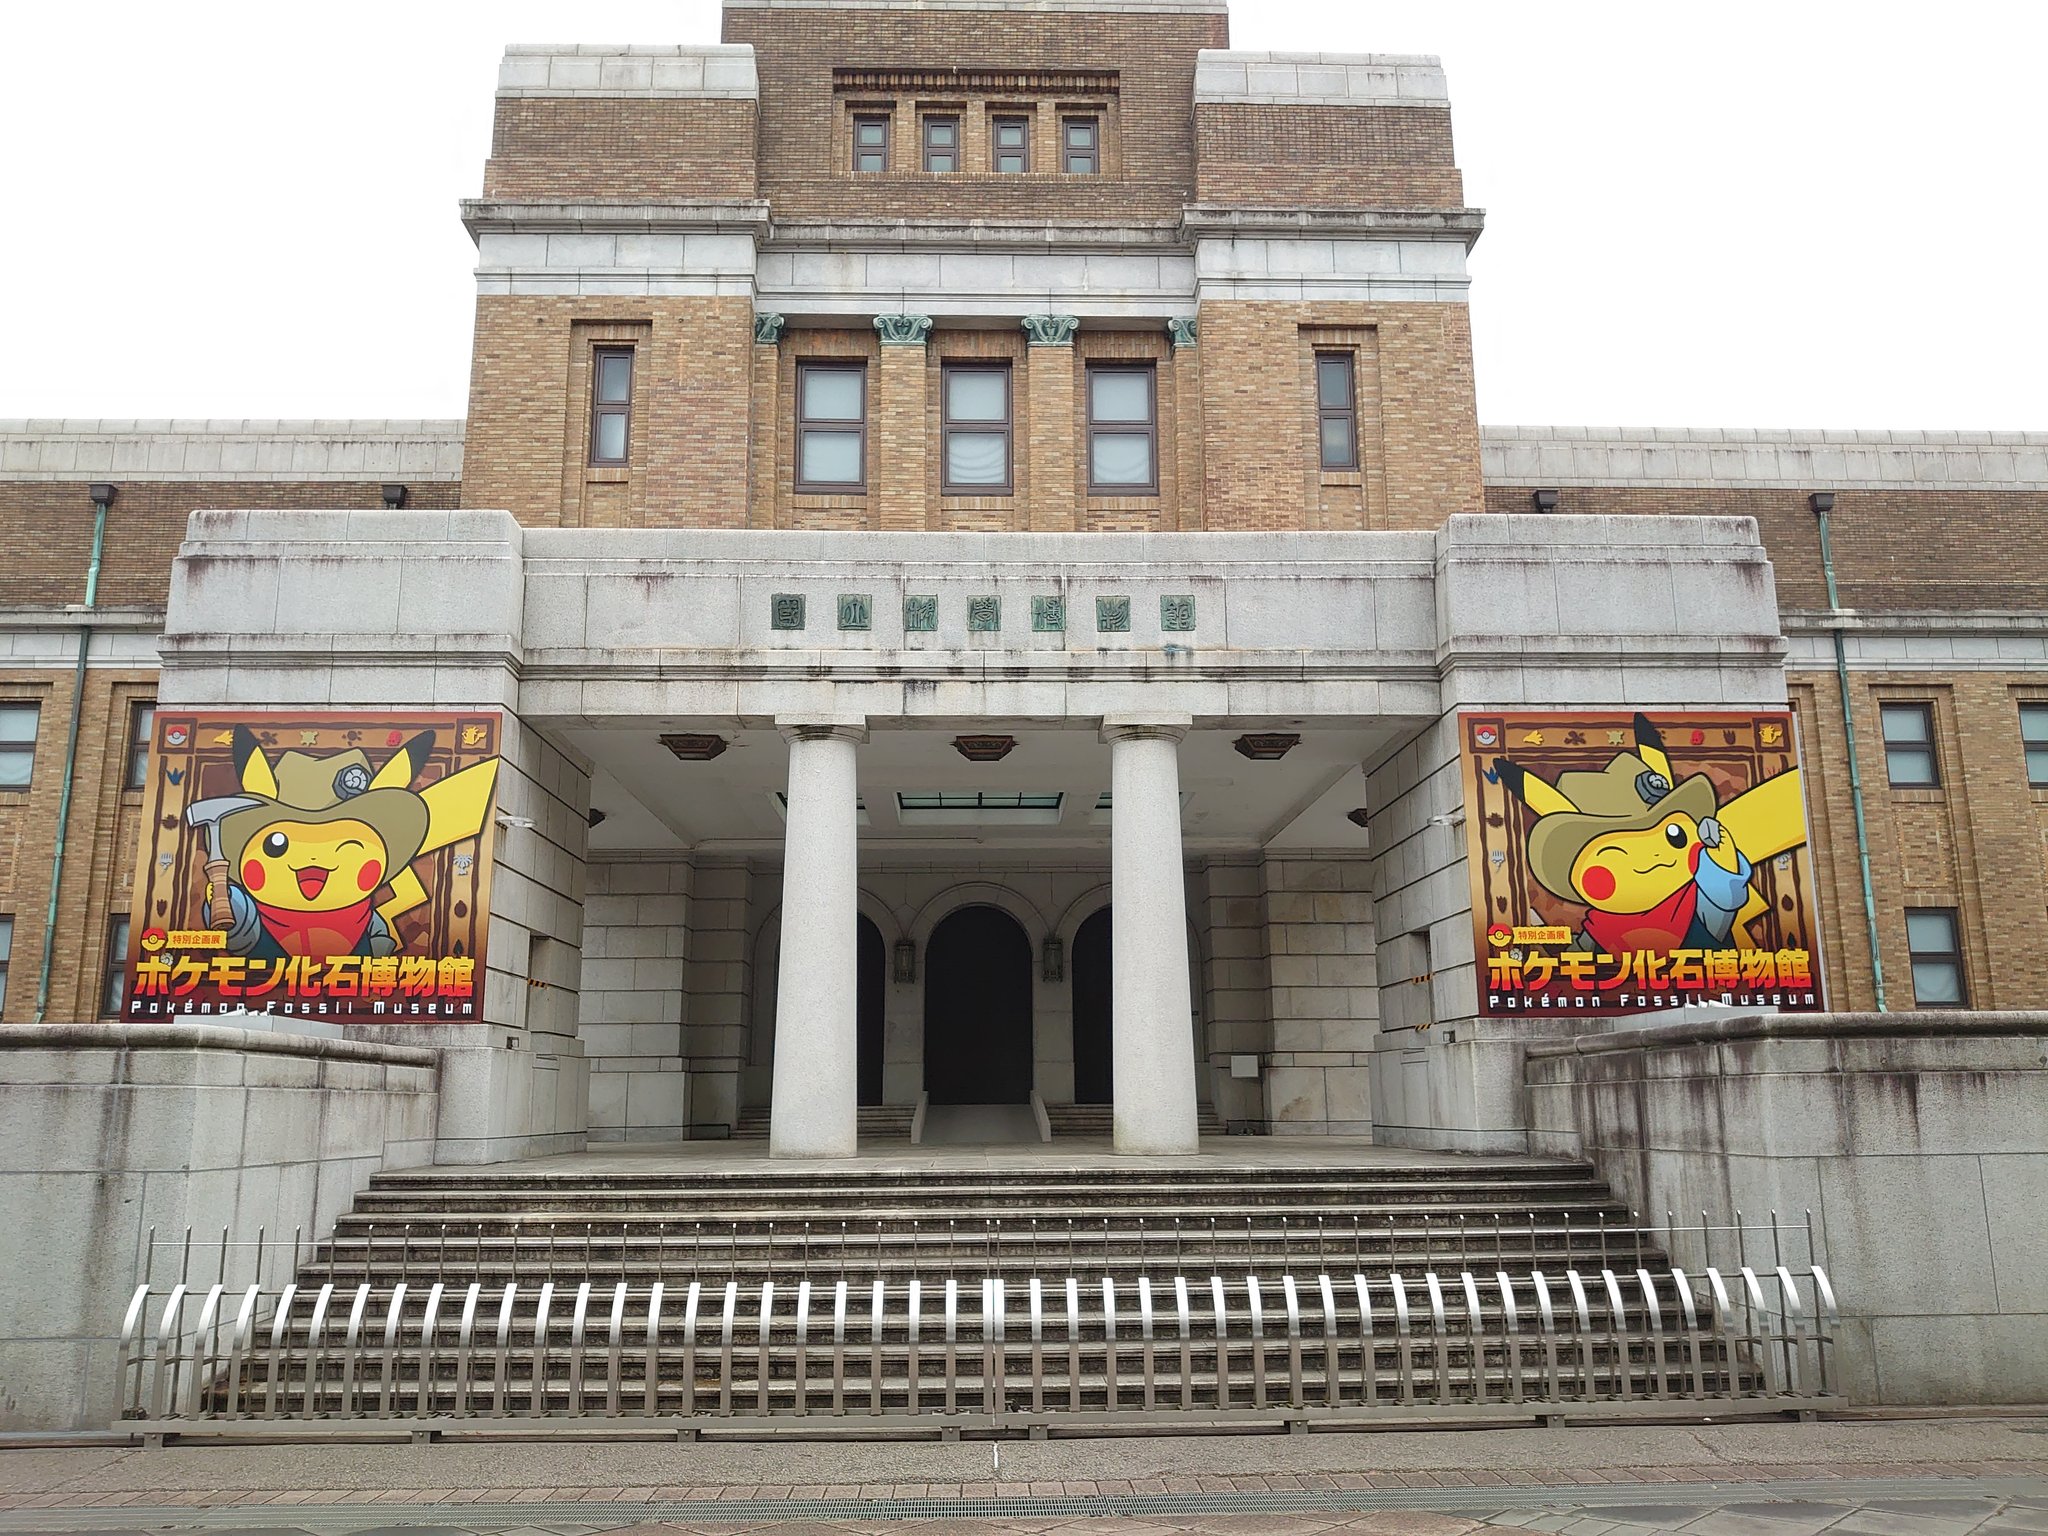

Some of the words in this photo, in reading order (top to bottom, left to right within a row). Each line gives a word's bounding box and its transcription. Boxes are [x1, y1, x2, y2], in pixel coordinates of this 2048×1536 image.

[172, 934, 221, 945] 特別企画展
[1518, 930, 1566, 940] 特別企画展
[133, 955, 475, 998] ポケモン化石博物館
[1487, 948, 1813, 991] ポケモン化石博物館
[266, 1000, 353, 1014] Fossil
[373, 1001, 472, 1014] Museum
[1489, 992, 1600, 1008] Pokémon
[1721, 993, 1814, 1005] Museum
